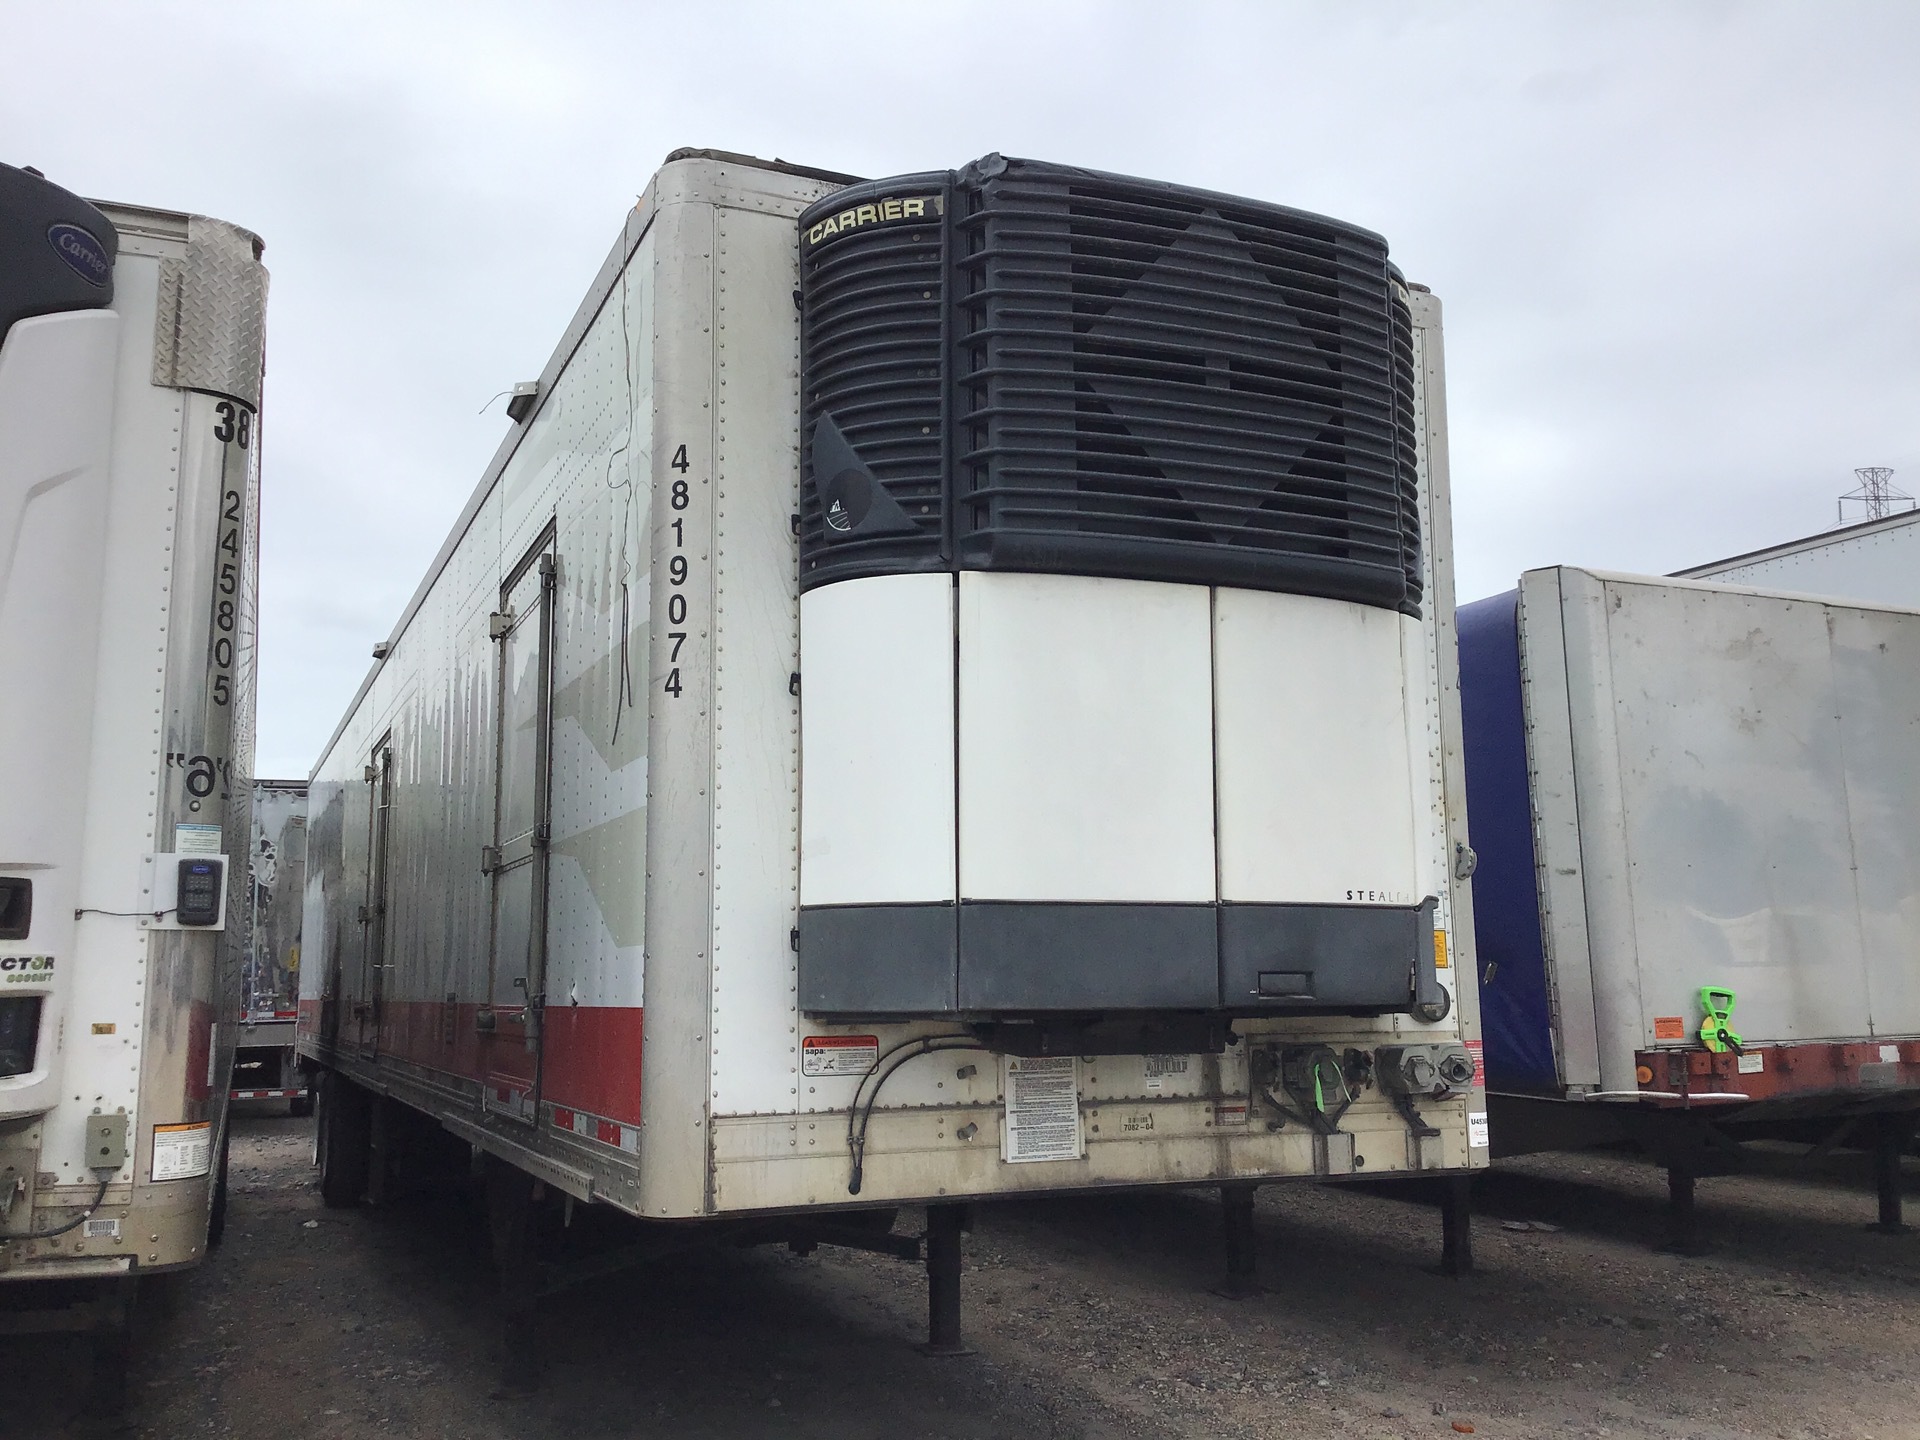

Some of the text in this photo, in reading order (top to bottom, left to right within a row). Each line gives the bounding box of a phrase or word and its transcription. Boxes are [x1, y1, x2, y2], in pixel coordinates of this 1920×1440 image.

[809, 199, 925, 245] CARRIER
[60, 233, 107, 272] Carrier
[214, 401, 251, 450] 38
[664, 443, 690, 699] 4819074
[212, 490, 241, 706] 245805
[0, 956, 54, 971] CTOR
